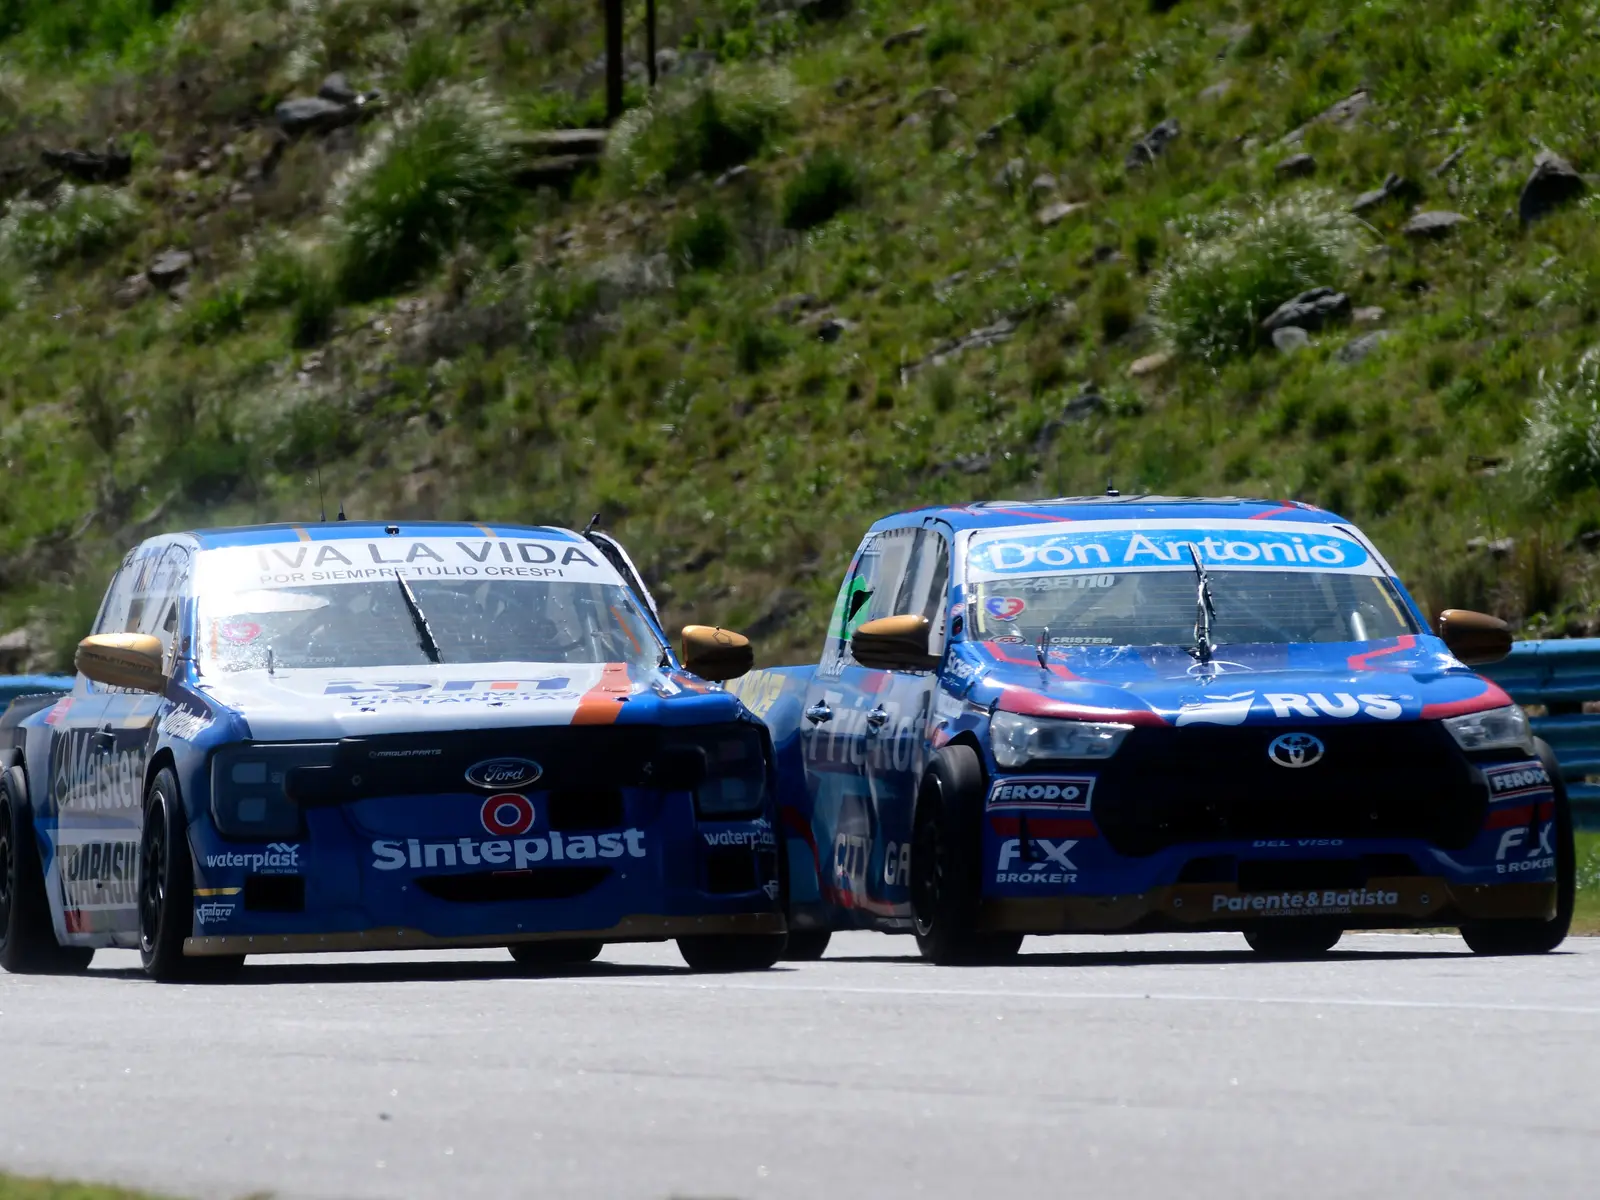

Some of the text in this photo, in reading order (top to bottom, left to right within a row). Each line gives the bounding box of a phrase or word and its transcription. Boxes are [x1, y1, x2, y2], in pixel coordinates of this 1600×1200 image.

[368, 542, 445, 564] LA
[455, 541, 599, 567] VIDA
[990, 533, 1345, 570] Don Antonio
[260, 566, 564, 585] POR SIEMPRE TULIO CRESPI
[1050, 637, 1114, 645] CRISTEM
[1262, 692, 1403, 721] RUS
[69, 729, 142, 810] Meister
[484, 763, 525, 782] Ford
[991, 784, 1081, 802] FERODO
[371, 827, 647, 870] Sinteplast
[1252, 837, 1344, 848] DEL VISO
[206, 851, 299, 873] waterplast
[997, 838, 1080, 872] FX
[1495, 857, 1555, 874] BROKER
[995, 872, 1079, 884] BROKER
